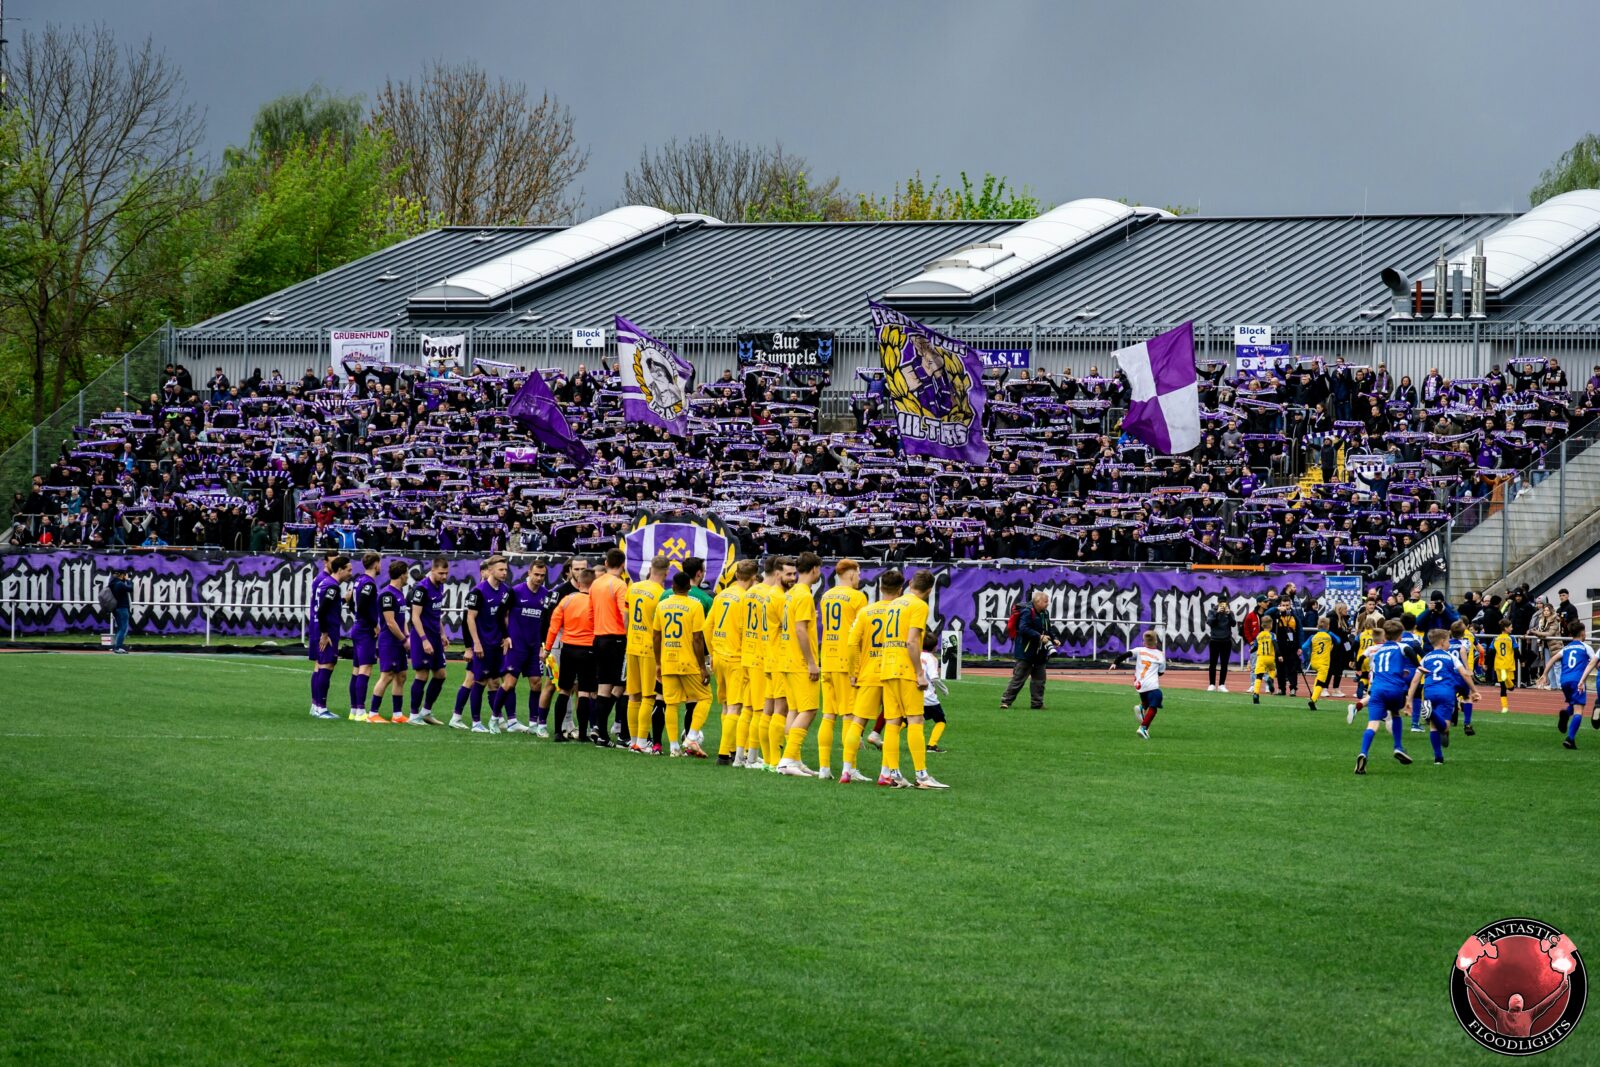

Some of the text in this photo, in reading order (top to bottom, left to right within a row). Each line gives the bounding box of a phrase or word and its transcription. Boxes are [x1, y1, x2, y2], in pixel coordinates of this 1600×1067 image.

[576, 329, 600, 338] Block
[1239, 326, 1266, 335] Block
[1249, 336, 1256, 344] C
[585, 338, 592, 346] C
[772, 332, 800, 350] Aue
[897, 412, 969, 446] ULTRAS
[1, 562, 53, 616] ein
[633, 598, 643, 623] 6
[718, 602, 730, 629] 7
[825, 602, 842, 631] 19
[664, 612, 683, 639] 25
[886, 608, 901, 638] 21
[1261, 641, 1270, 656] 11
[1317, 641, 1325, 655] 3
[1499, 642, 1506, 657] 8
[1378, 651, 1391, 673] 11
[1567, 649, 1577, 669] 6
[1140, 660, 1152, 679] 7
[1432, 660, 1443, 681] 2
